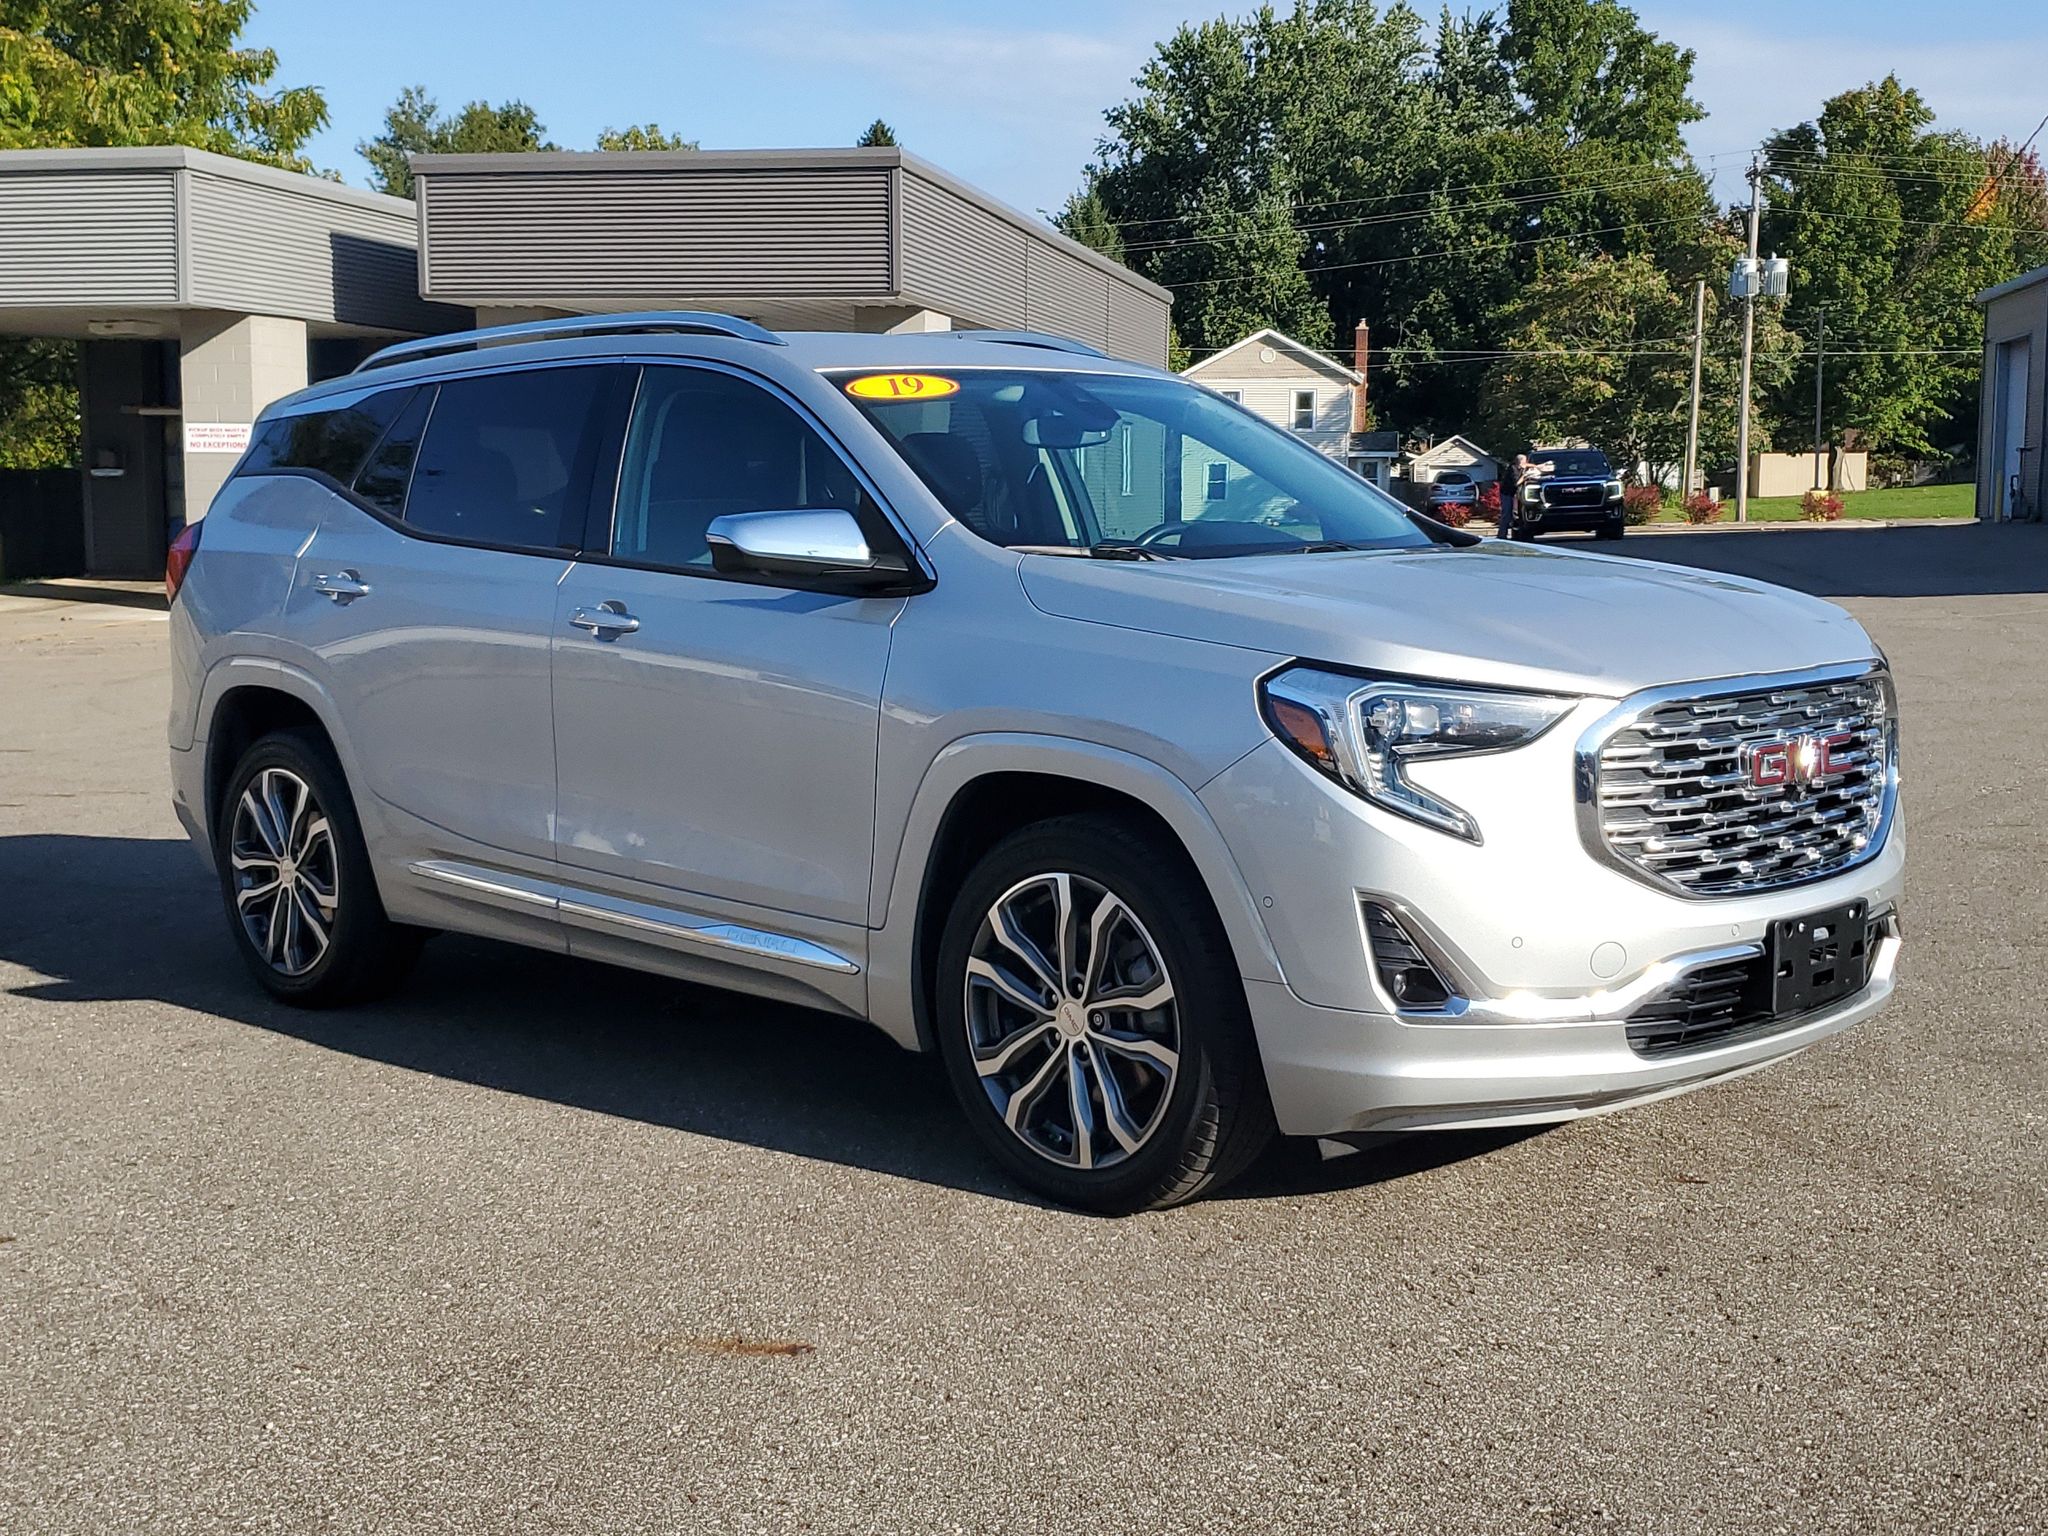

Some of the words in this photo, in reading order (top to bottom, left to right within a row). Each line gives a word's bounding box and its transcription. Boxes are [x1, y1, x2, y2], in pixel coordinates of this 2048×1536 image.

[887, 376, 924, 396] 19
[190, 441, 202, 449] NO
[203, 441, 248, 450] EXCEPTIONS
[1750, 732, 1853, 787] GMC
[726, 928, 800, 953] DENALI
[1063, 1006, 1080, 1031] GMC
